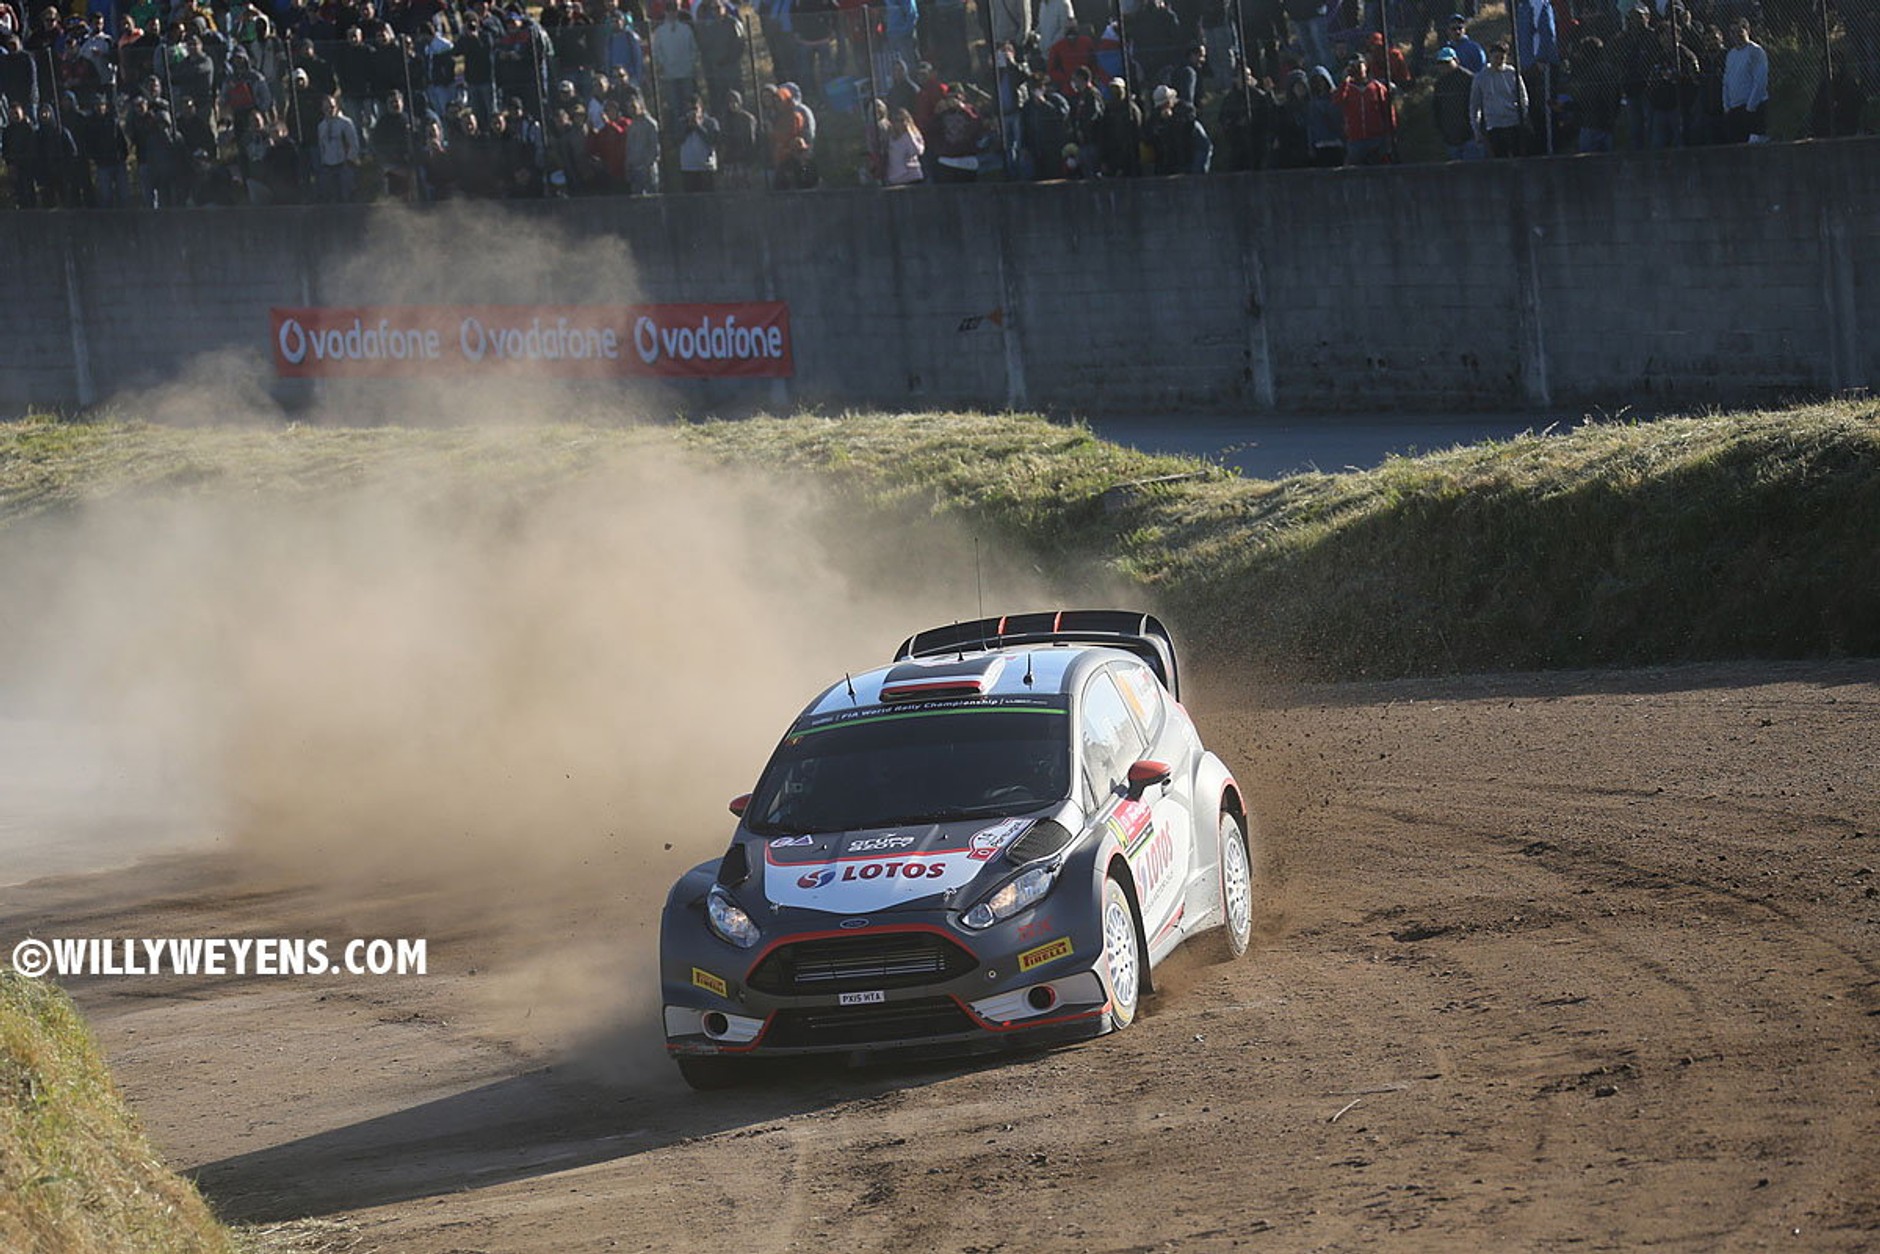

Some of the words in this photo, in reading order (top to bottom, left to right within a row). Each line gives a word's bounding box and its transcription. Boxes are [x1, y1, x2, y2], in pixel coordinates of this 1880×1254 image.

[309, 319, 440, 360] vodafone
[490, 317, 620, 360] vodafone
[662, 315, 782, 360] vodafone
[861, 706, 893, 718] World
[895, 703, 920, 715] Rally
[924, 697, 998, 711] Championship
[1146, 820, 1174, 892] LOTOS
[841, 862, 947, 882] LOTOS
[1022, 941, 1068, 969] PIRELLI
